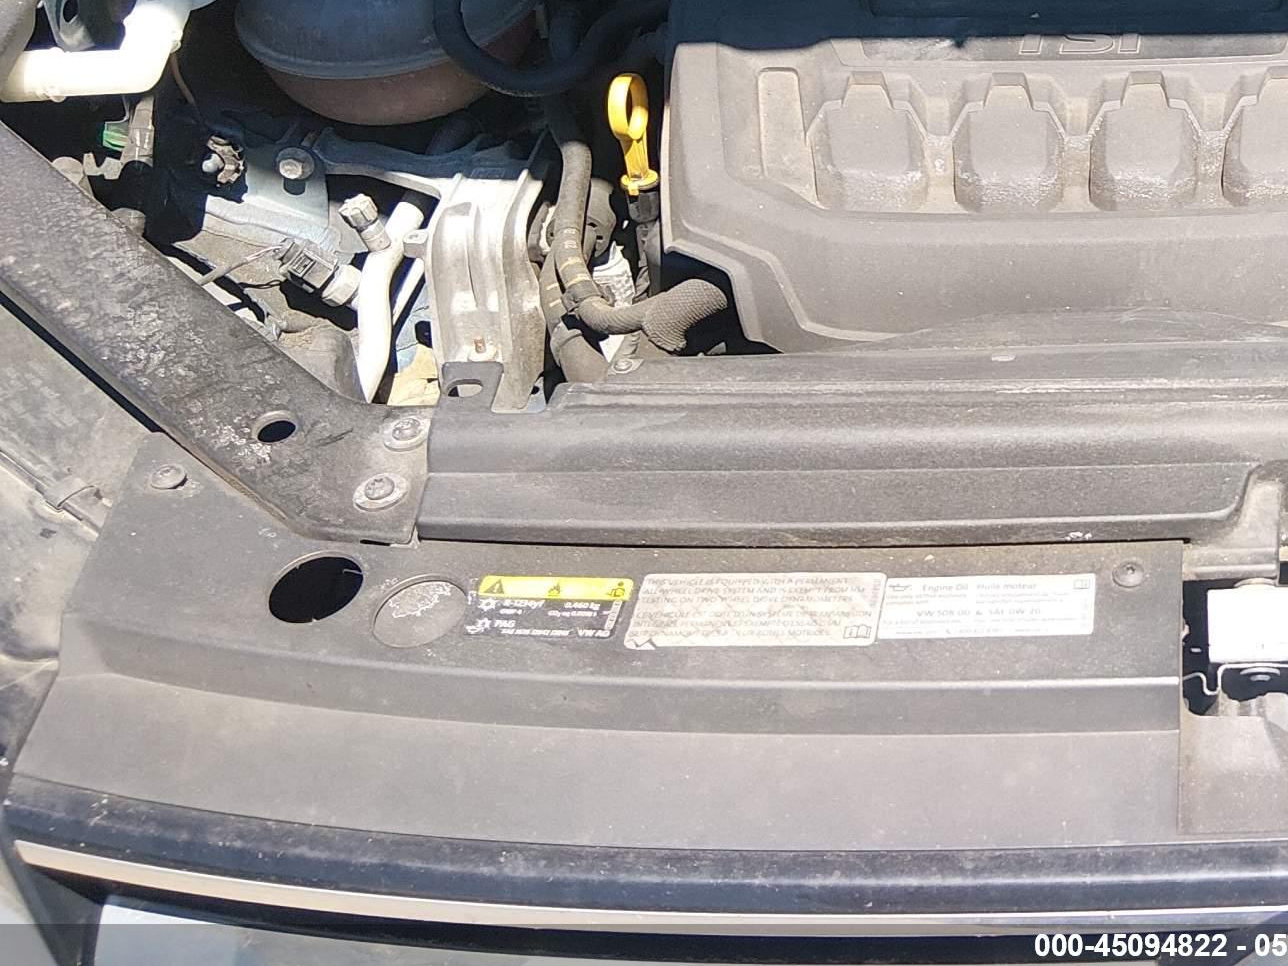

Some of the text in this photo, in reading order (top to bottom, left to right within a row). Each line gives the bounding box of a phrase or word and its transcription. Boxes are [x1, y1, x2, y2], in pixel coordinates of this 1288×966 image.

[922, 583, 969, 593] Engine Oil
[916, 610, 936, 618] VW
[494, 619, 516, 628] PAG
[577, 627, 611, 637] VW AG
